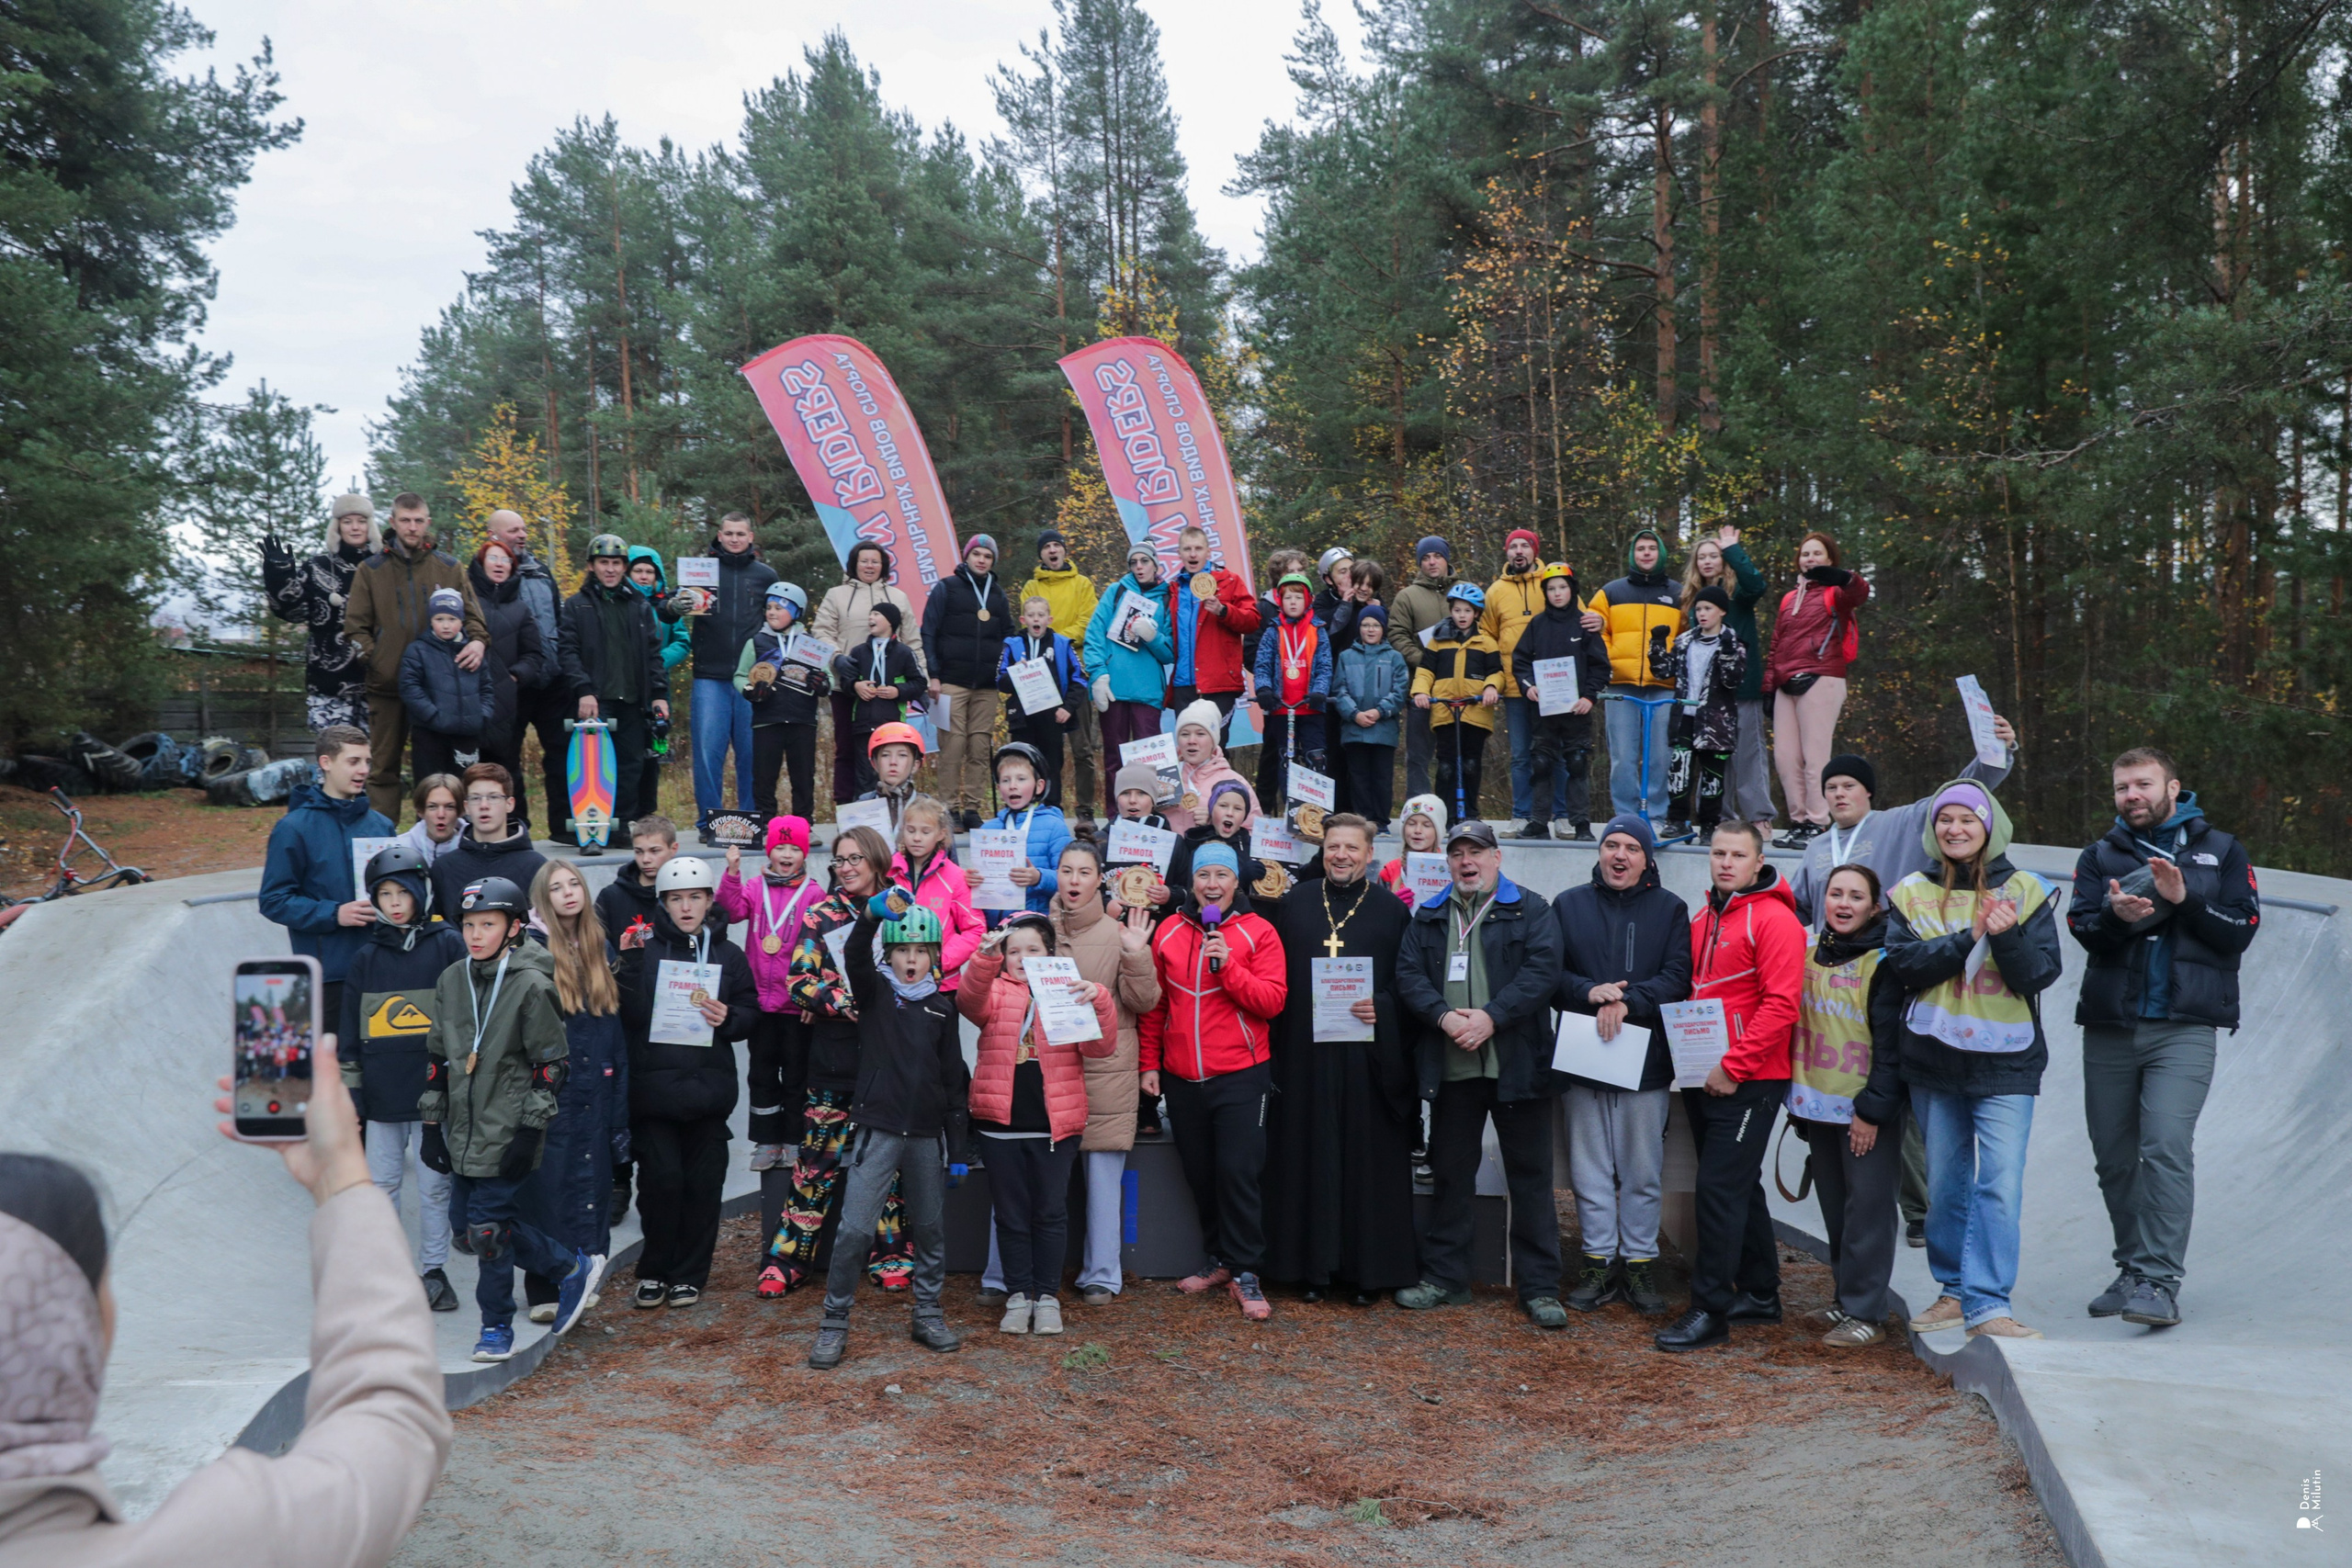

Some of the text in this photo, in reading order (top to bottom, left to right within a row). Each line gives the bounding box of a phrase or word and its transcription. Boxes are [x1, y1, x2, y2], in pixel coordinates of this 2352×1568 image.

[1297, 783, 1326, 799] ГРАМОТА
[1261, 838, 1293, 851] ГРАМОТА
[980, 850, 1015, 858] ГРАМОТА
[1119, 846, 1154, 858] ГРАМОТА
[1683, 1027, 1711, 1036] ПИСЬМО
[1736, 1108, 1752, 1143] FINNTRAIL
